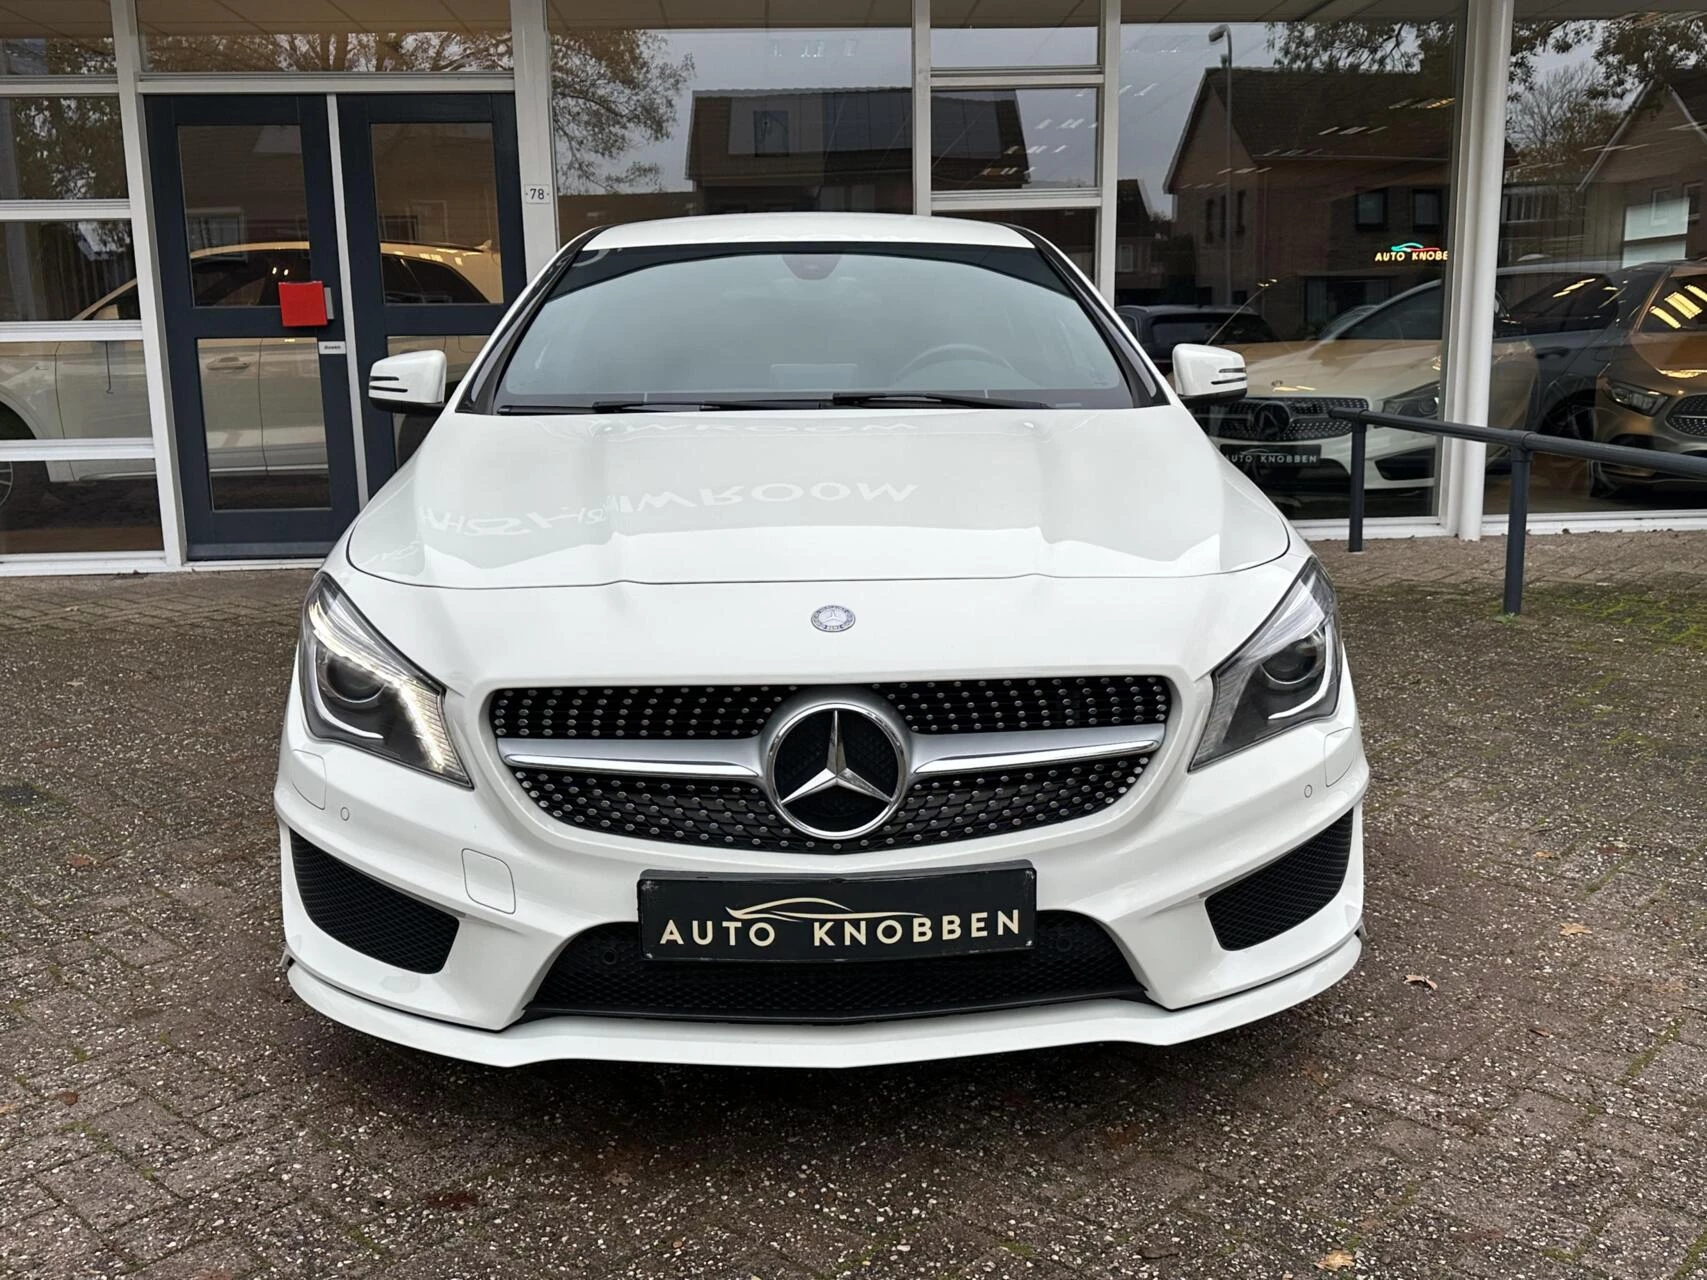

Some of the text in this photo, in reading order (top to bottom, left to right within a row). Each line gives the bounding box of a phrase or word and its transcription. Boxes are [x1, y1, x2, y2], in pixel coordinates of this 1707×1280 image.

[529, 188, 545, 200] 78
[1374, 251, 1406, 262] AUTO
[1260, 454, 1317, 463] KNOBBEN
[659, 908, 1020, 947] AUTO KNOBBEN
